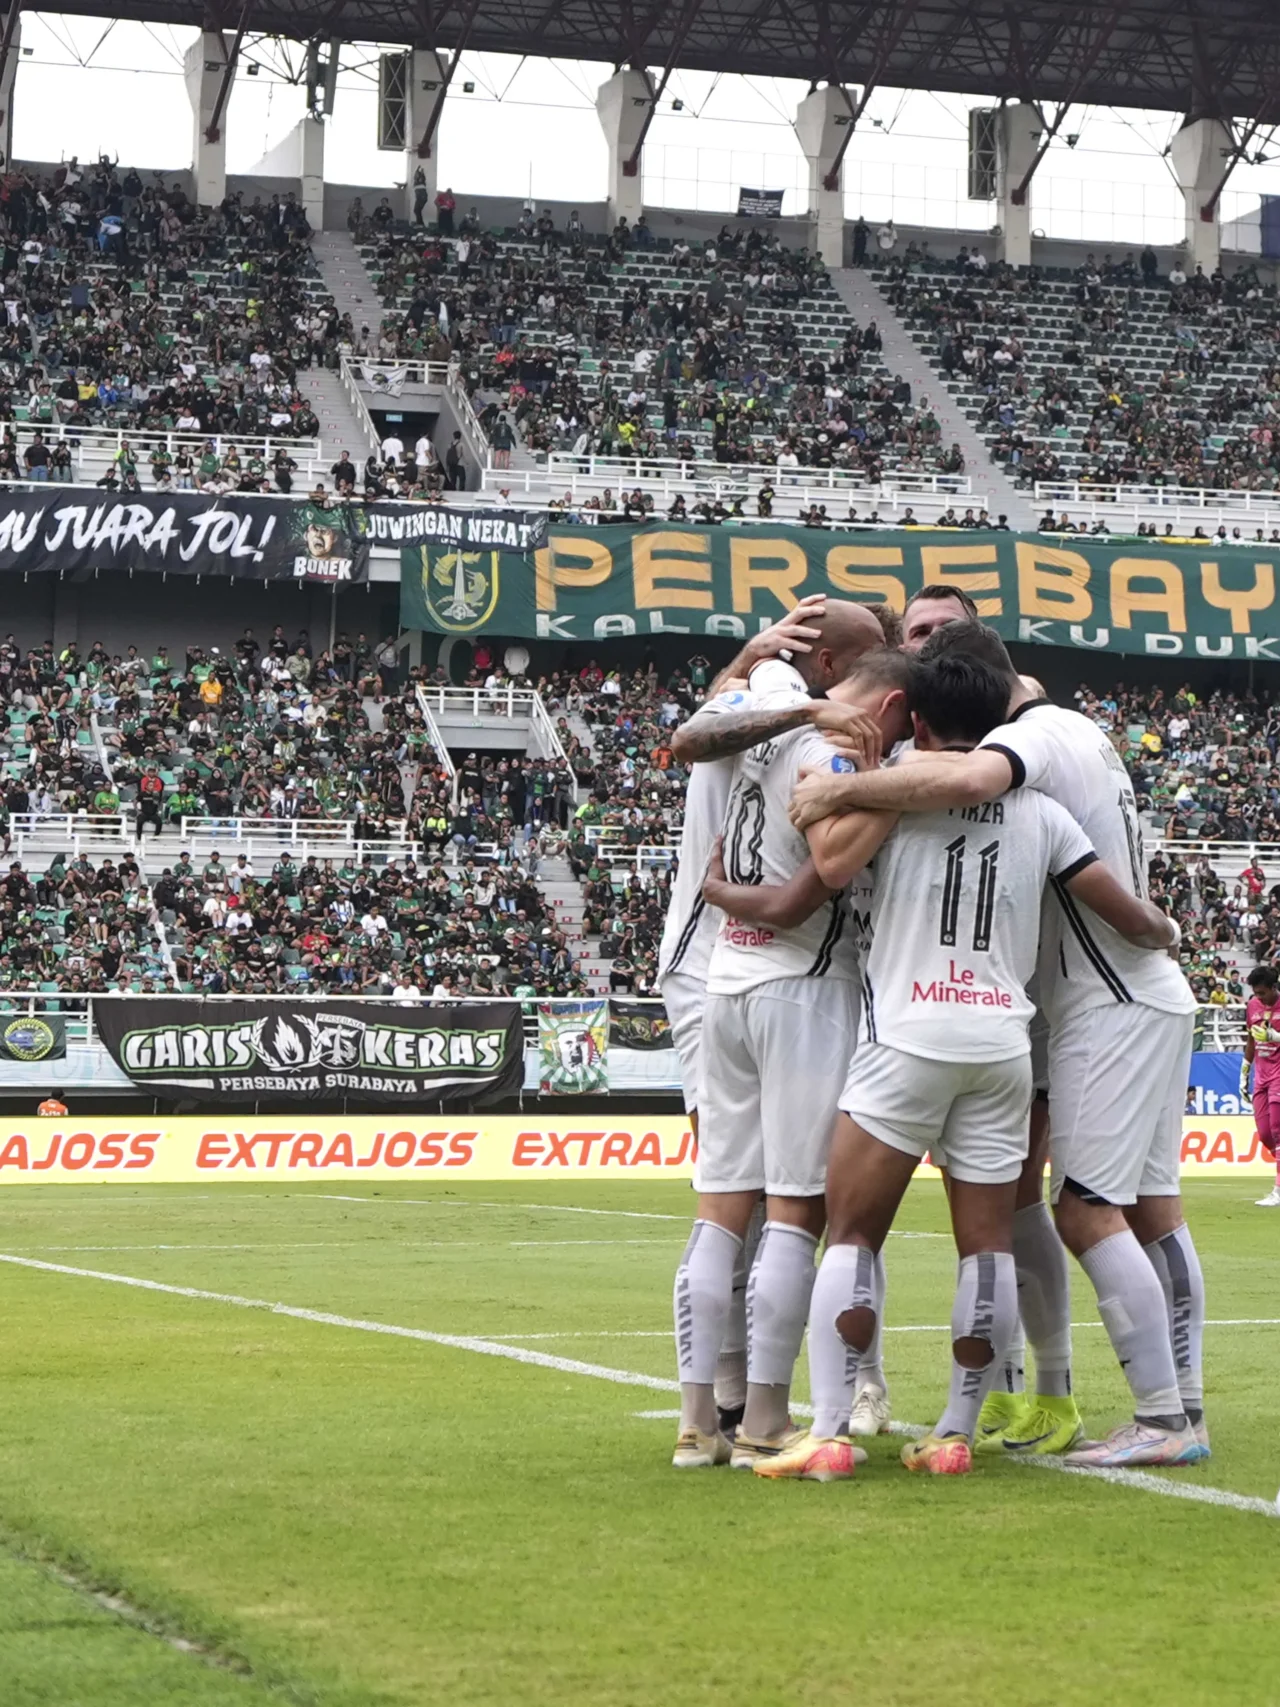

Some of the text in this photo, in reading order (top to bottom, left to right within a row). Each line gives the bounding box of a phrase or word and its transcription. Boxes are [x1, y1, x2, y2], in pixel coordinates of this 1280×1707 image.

[45, 502, 181, 557] JUARA
[180, 500, 277, 562] JOL!
[365, 510, 531, 548] JUWINGAN NEKAT
[293, 556, 352, 580] BONEK
[535, 611, 773, 641] KALA
[1018, 618, 1111, 648] KU
[939, 834, 1000, 952] 11
[950, 960, 975, 985] Le
[911, 980, 1012, 1009] Minerale
[125, 1026, 501, 1069] GARIS KERAS
[220, 1073, 418, 1093] PERSEBAYA SURABAYA
[196, 1131, 479, 1168] EXTRAJOSS
[512, 1131, 699, 1167] EXTRAJ
